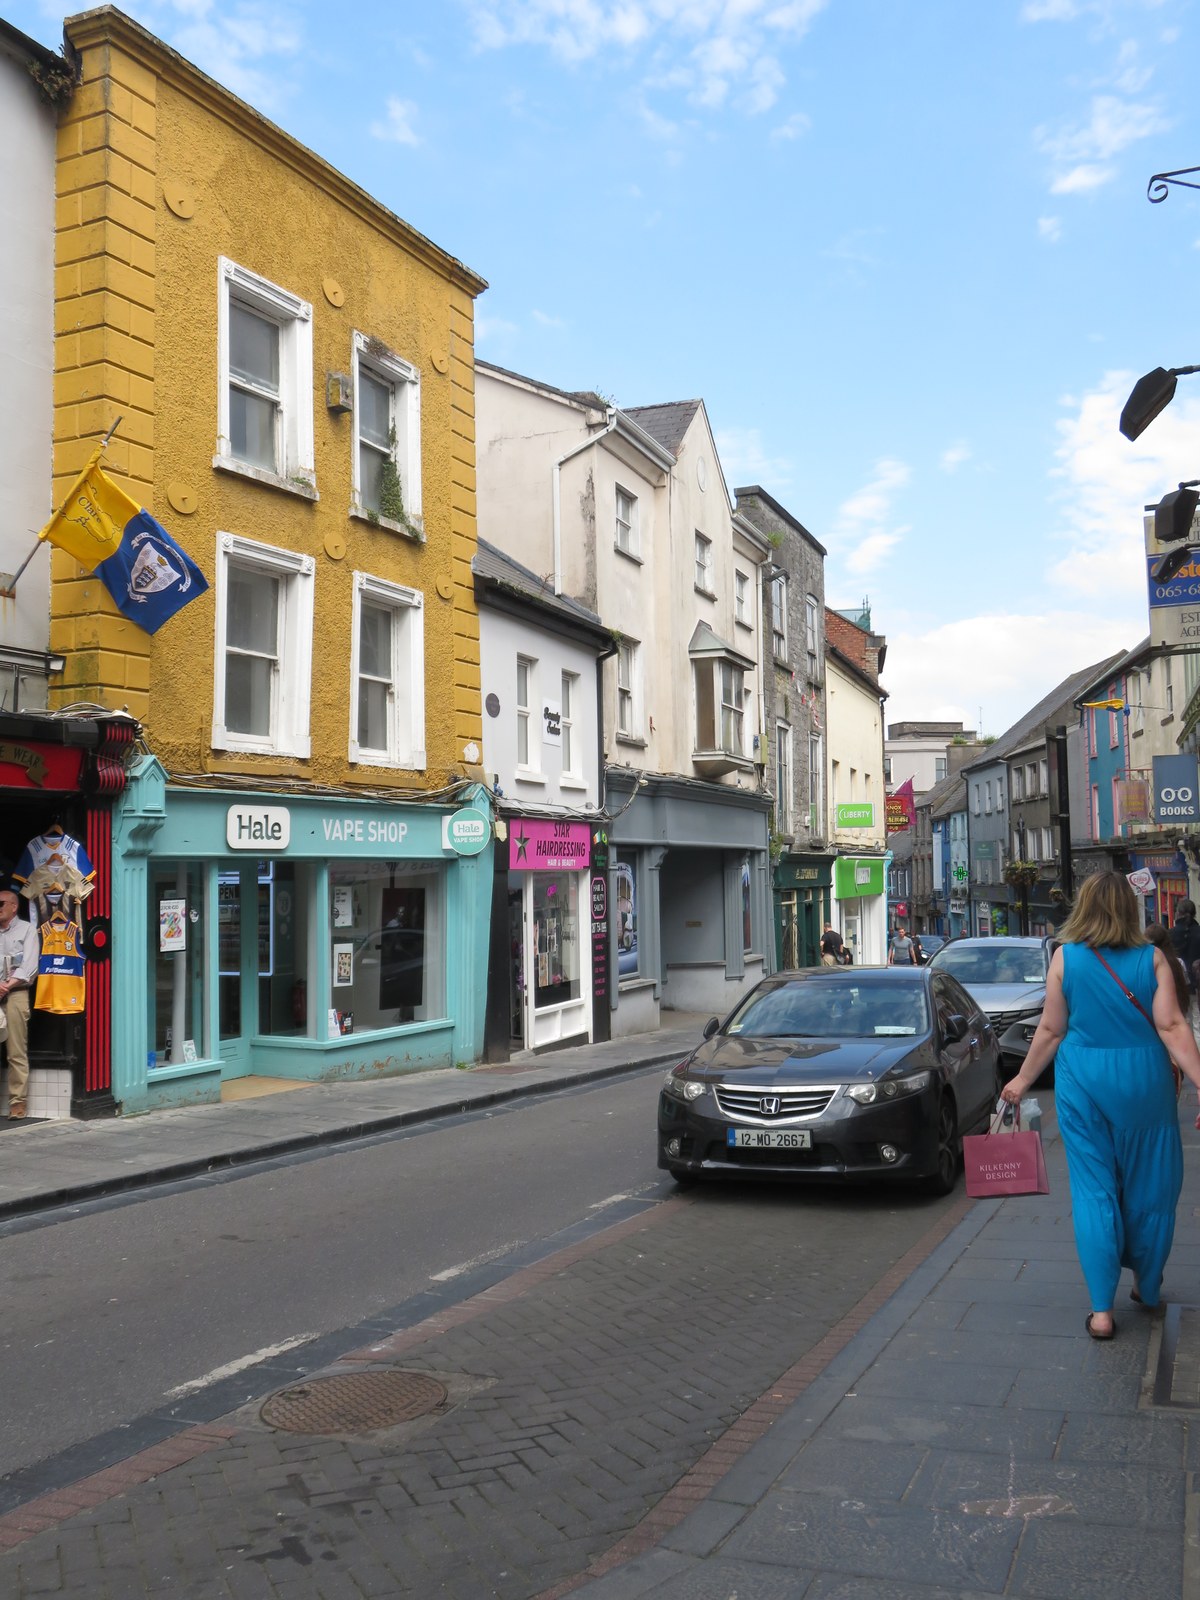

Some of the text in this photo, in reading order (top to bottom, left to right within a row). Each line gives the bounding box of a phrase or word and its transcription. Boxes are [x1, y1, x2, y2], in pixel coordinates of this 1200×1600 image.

[78, 496, 102, 523] Clare
[14, 747, 41, 768] WEAR
[843, 810, 870, 819] LIBERTY
[1160, 806, 1195, 816] BOOKS
[237, 814, 281, 841] Hale
[322, 818, 407, 843] VAPE SHOP
[457, 824, 480, 833] Hale
[554, 822, 570, 838] STAR
[536, 840, 586, 857] HAIRDRESSING
[547, 858, 557, 867] HAIR
[561, 858, 576, 867] BEAUTY
[220, 887, 234, 900] PEN
[741, 1133, 805, 1147] 12-MO-2667
[980, 1162, 1021, 1172] KILKENNY
[986, 1171, 1017, 1180] DESIGN
